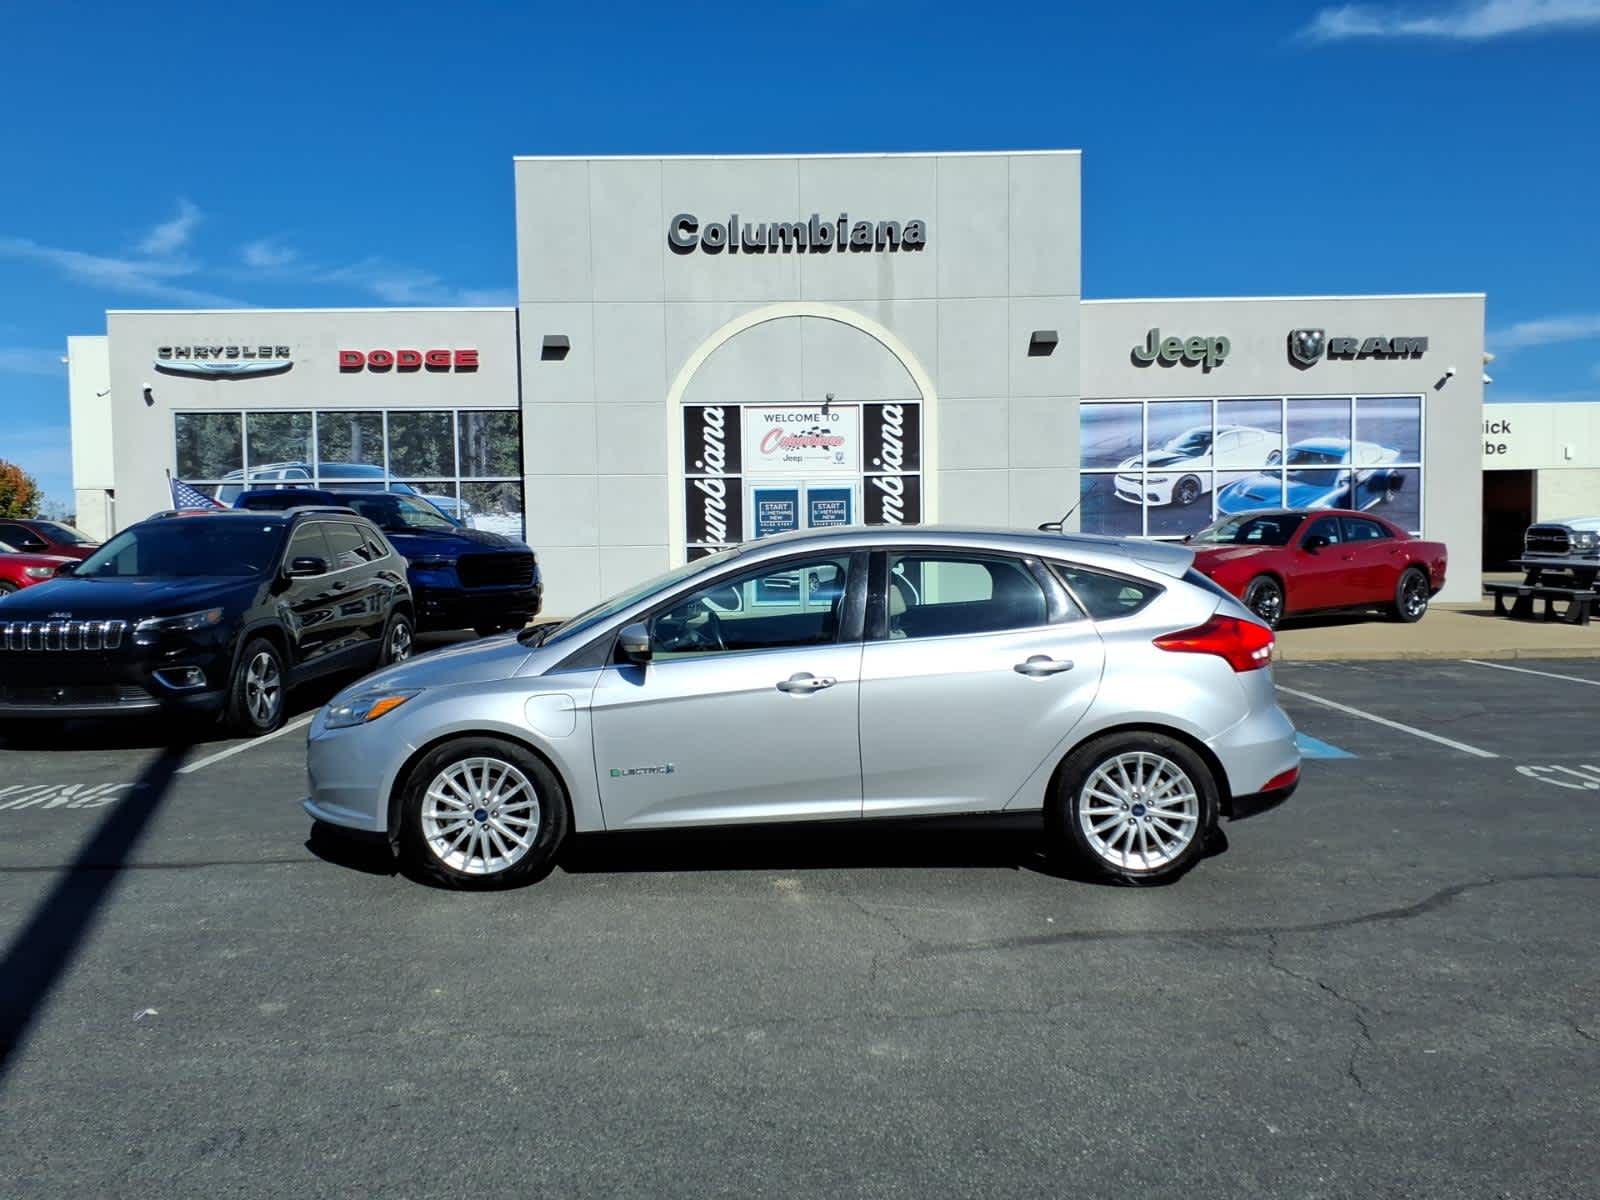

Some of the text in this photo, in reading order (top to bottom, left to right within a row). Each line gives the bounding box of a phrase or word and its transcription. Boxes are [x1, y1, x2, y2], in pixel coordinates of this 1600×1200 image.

[668, 213, 926, 253] Columbiana
[157, 345, 291, 359] CHRYSLER
[1131, 328, 1231, 373] Jeep
[1327, 336, 1429, 360] RAM
[338, 350, 479, 372] DODGE
[764, 413, 840, 422] WELCOME TO
[1481, 420, 1511, 434] ick
